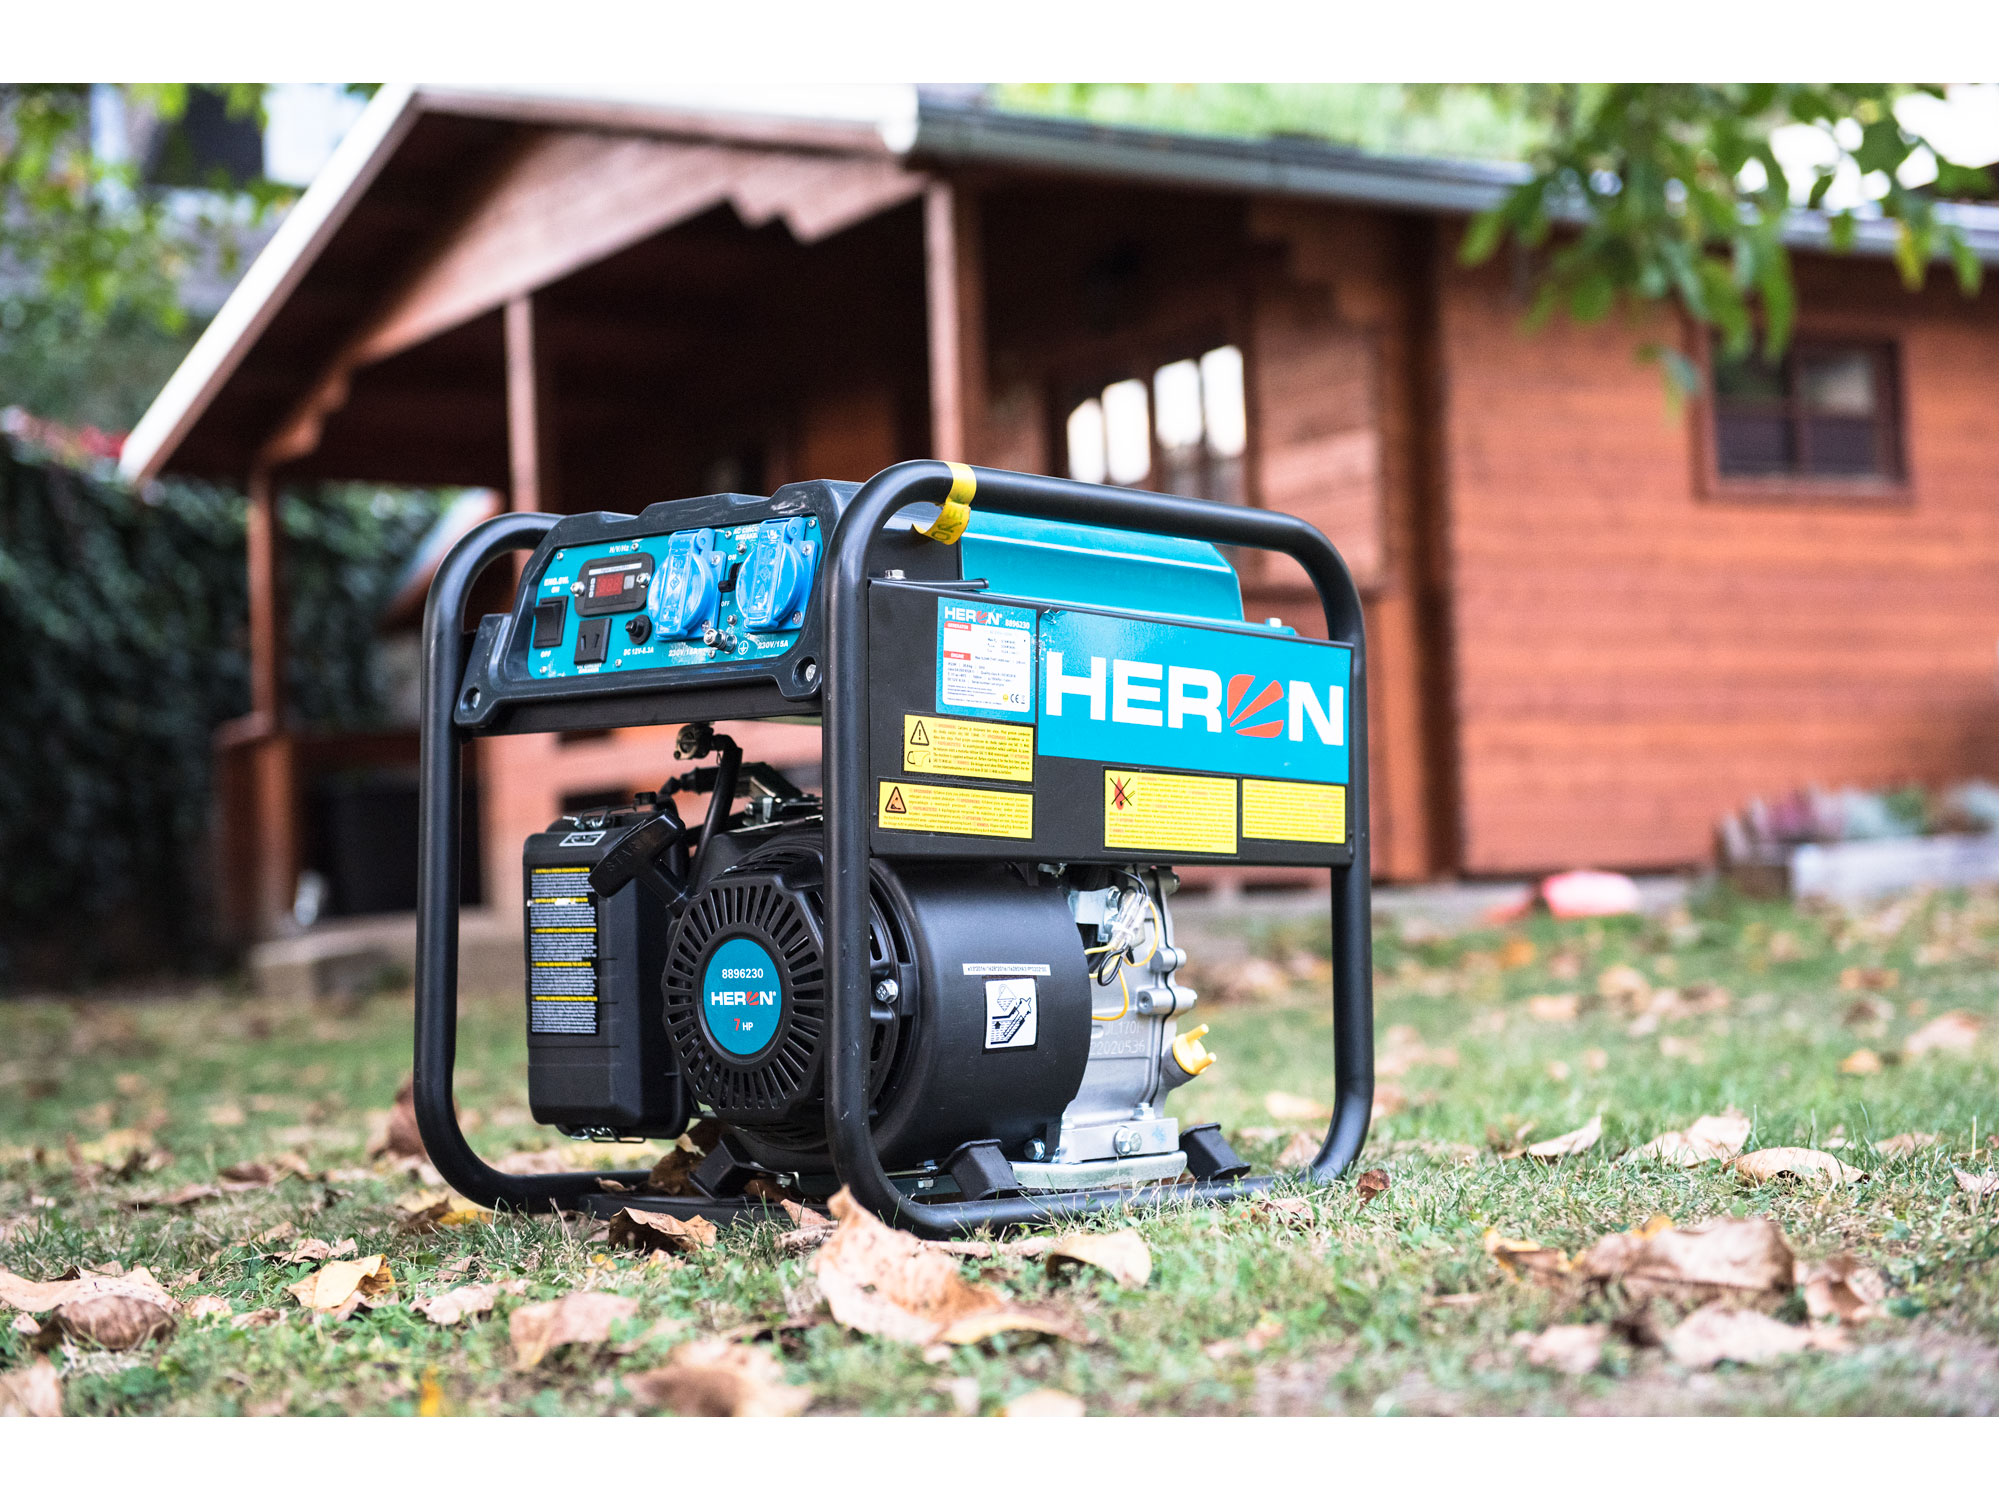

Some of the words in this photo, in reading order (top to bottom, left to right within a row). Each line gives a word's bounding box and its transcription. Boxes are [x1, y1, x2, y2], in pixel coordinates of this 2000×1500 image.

[728, 553, 737, 561] ON
[944, 606, 1003, 626] HERON
[1005, 618, 1030, 630] 8896230
[1045, 651, 1344, 746] HERON
[722, 968, 764, 979] 8896230
[711, 991, 776, 1006] HERON
[733, 1018, 741, 1031] 7
[742, 1022, 754, 1031] HP
